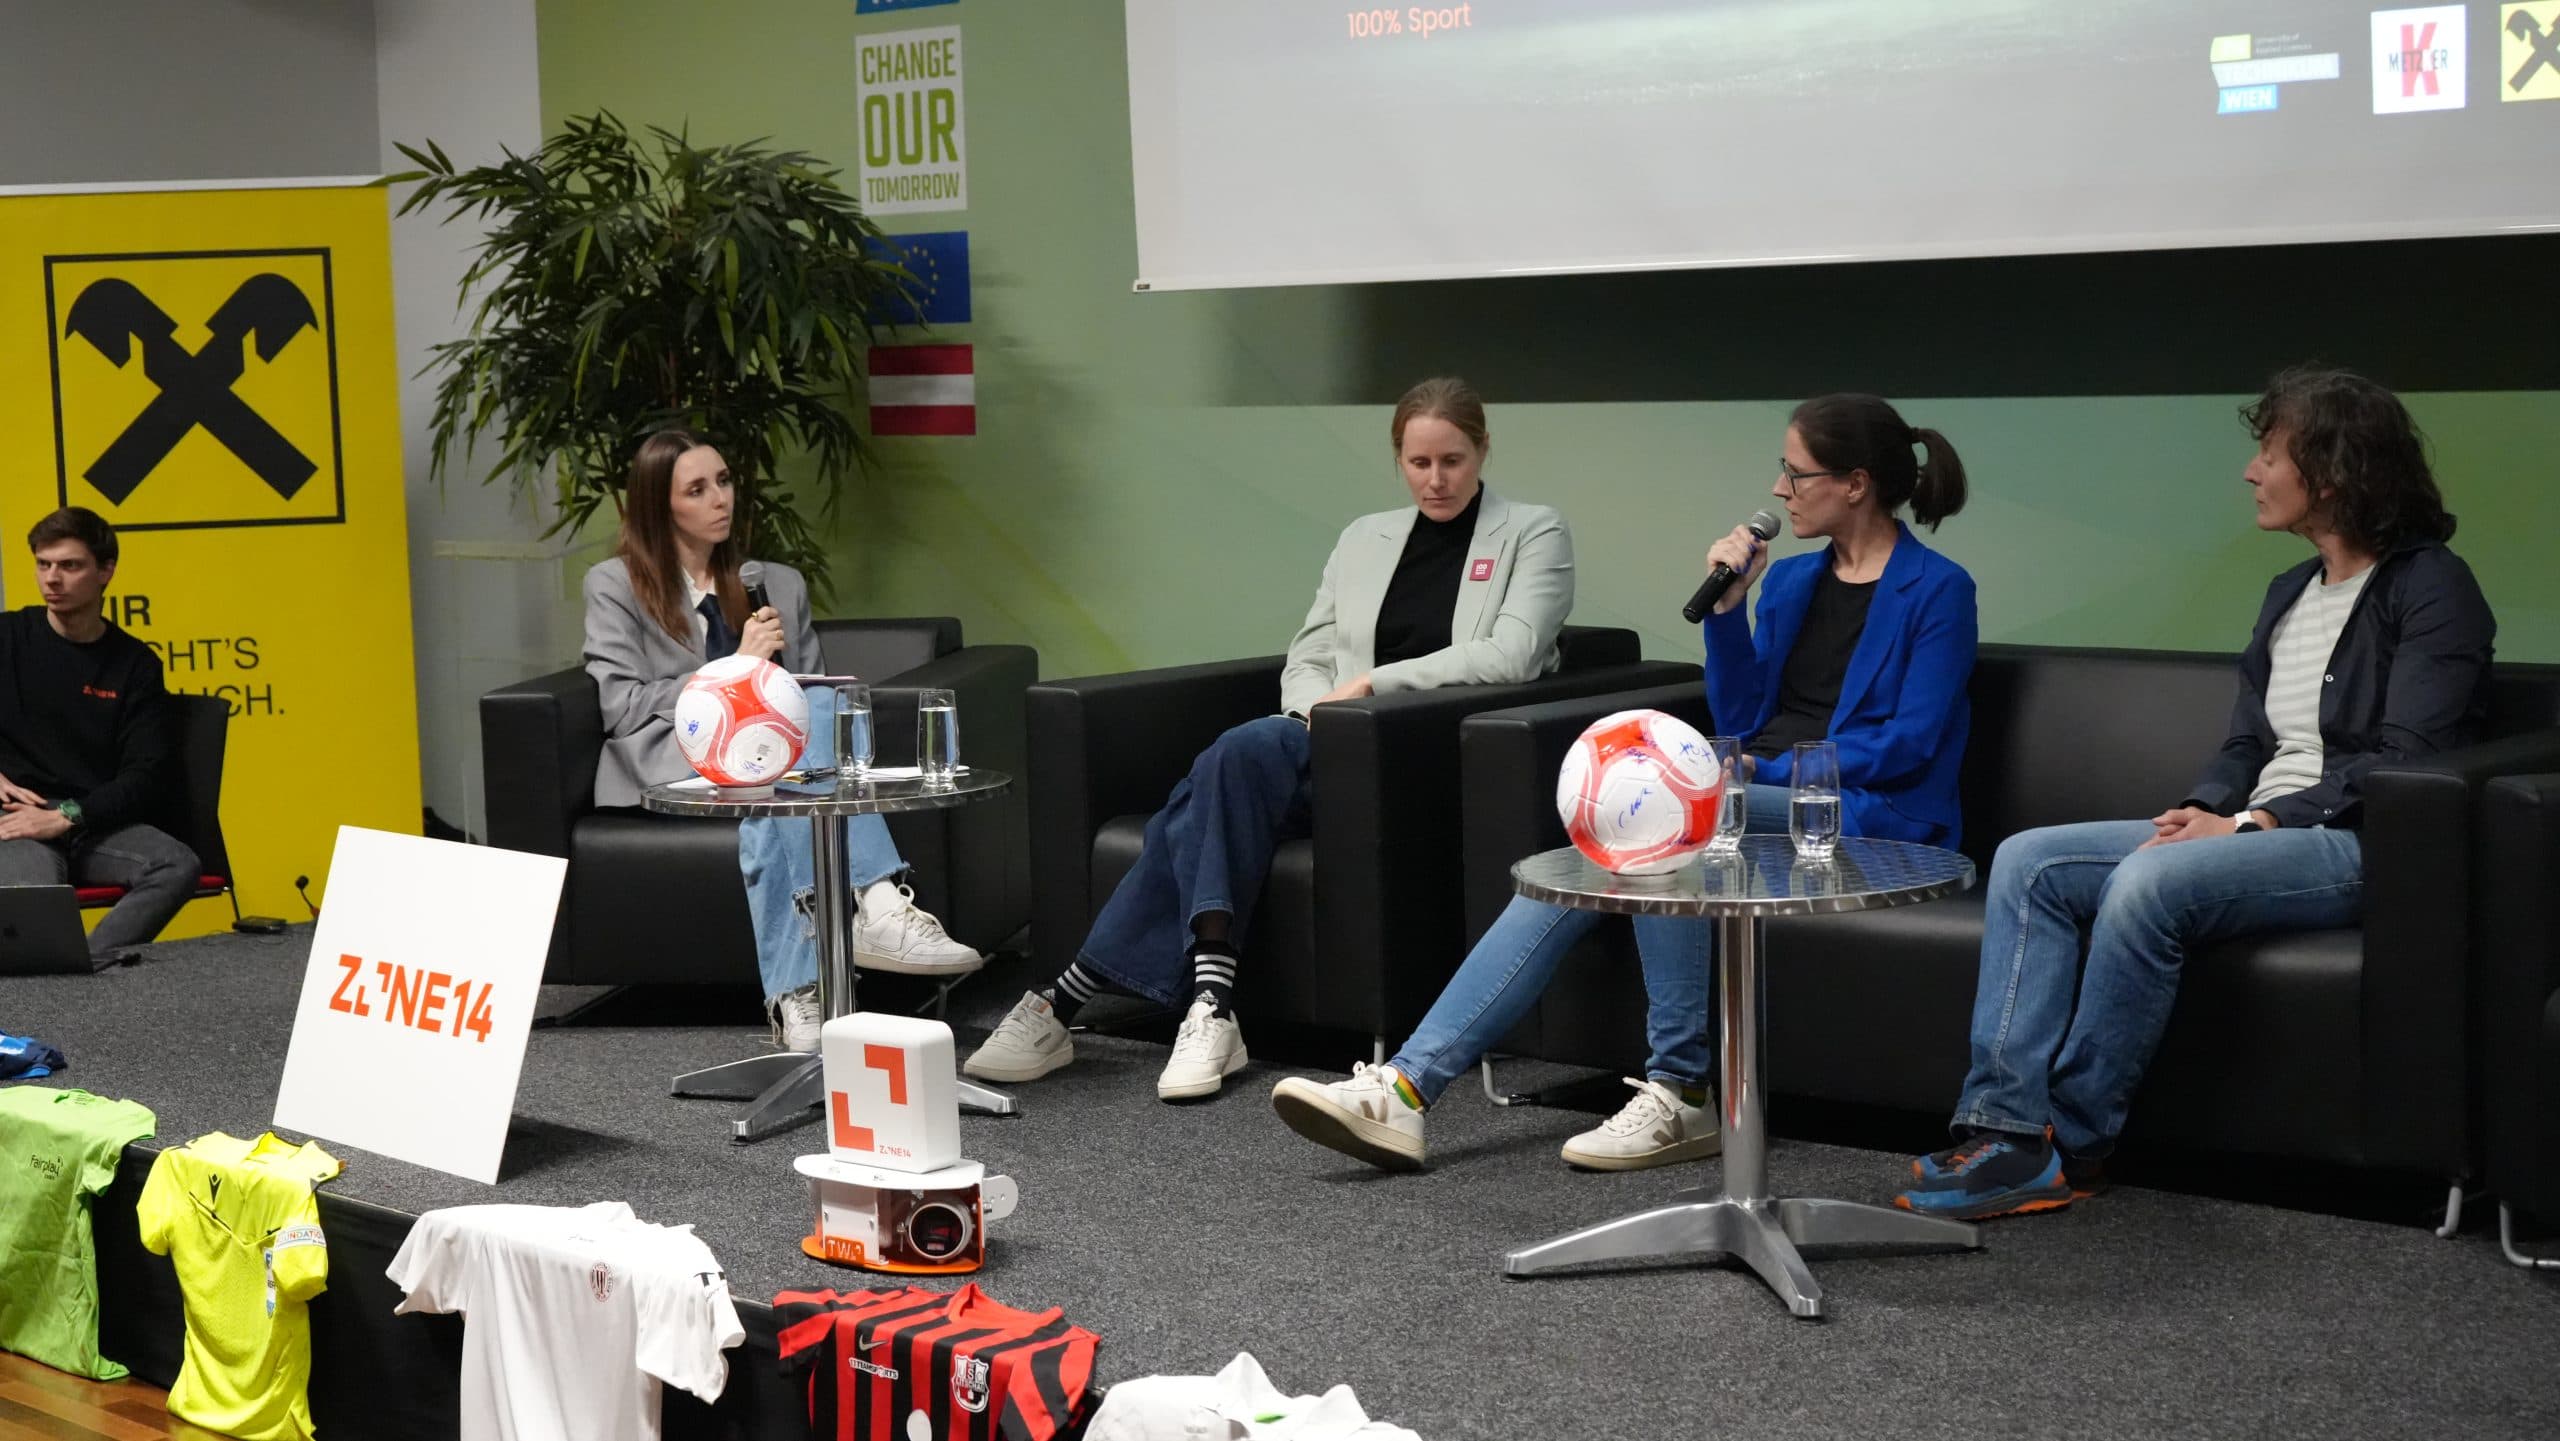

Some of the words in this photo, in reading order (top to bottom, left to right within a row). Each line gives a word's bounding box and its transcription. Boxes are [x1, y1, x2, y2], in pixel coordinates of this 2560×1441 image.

[1346, 9, 1402, 38] 100%
[1408, 1, 1472, 38] Sport
[862, 38, 956, 84] CHANGE
[2388, 49, 2448, 73] METZER
[2224, 89, 2272, 109] WIEN
[864, 88, 958, 167] OUR
[866, 172, 959, 204] TOMORROW
[102, 595, 151, 626] IR
